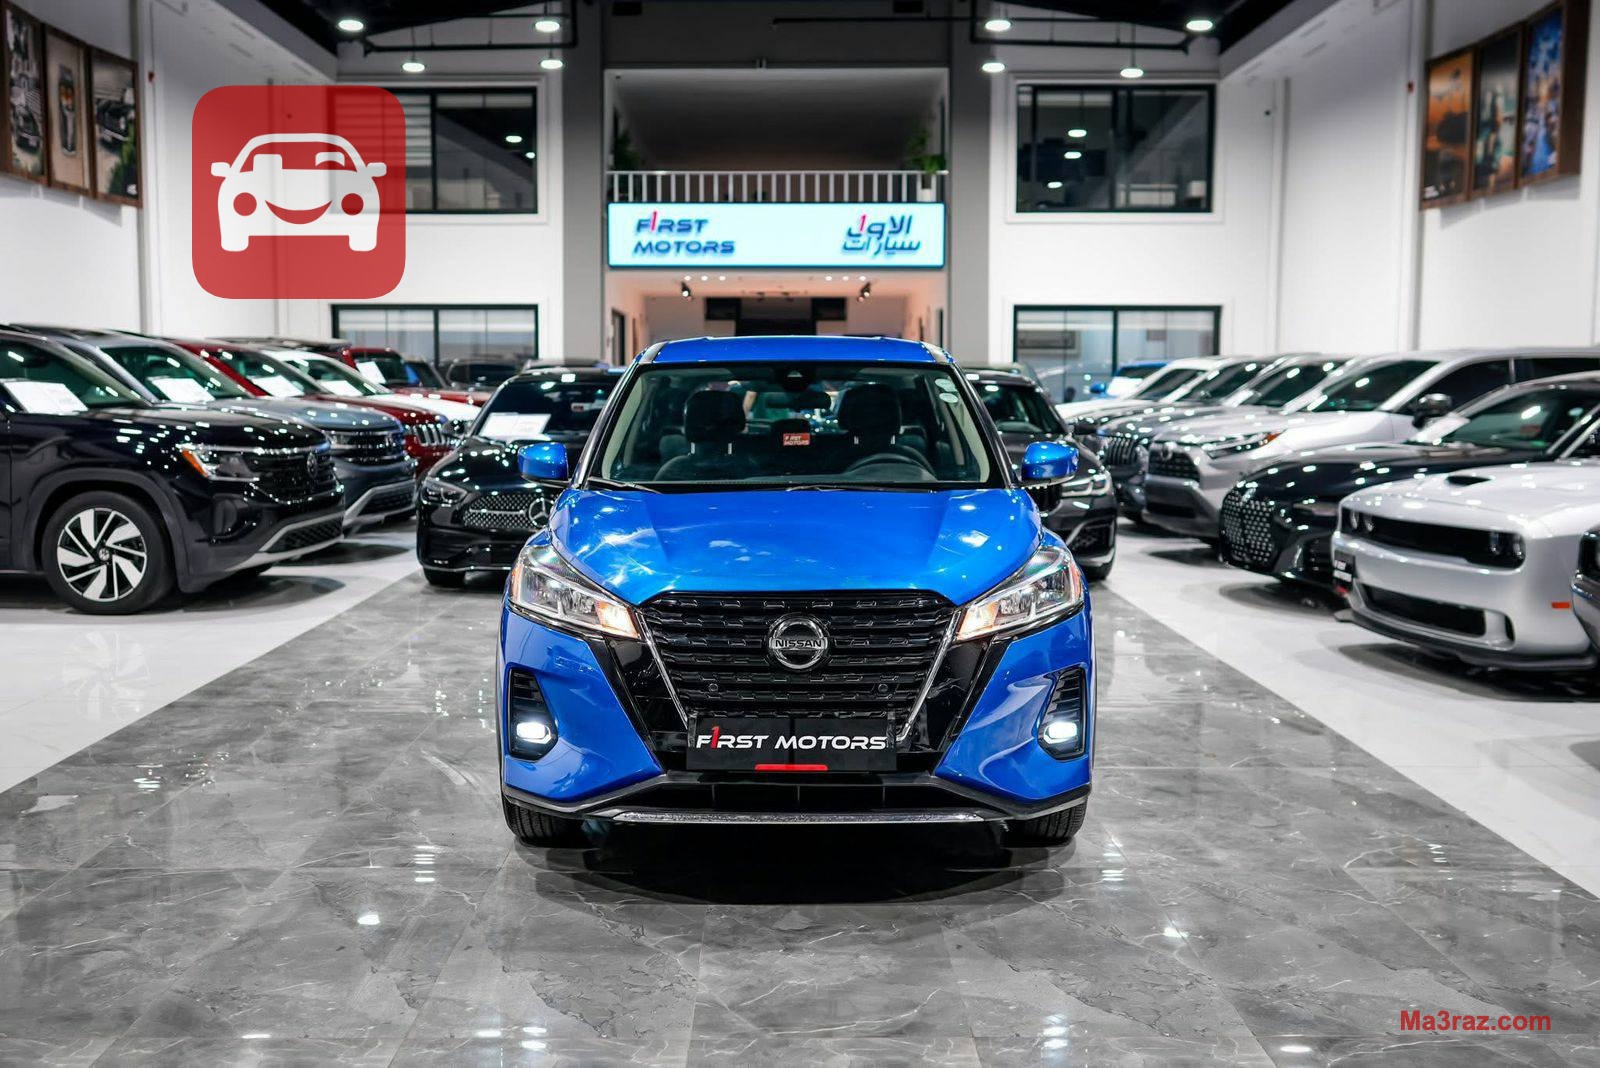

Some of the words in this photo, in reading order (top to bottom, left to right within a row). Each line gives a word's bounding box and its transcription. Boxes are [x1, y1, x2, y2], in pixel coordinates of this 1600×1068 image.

[633, 240, 735, 254] MOTORS
[843, 236, 921, 255] سيارات
[775, 640, 822, 648] NISSAN
[774, 735, 888, 750] MOTORS
